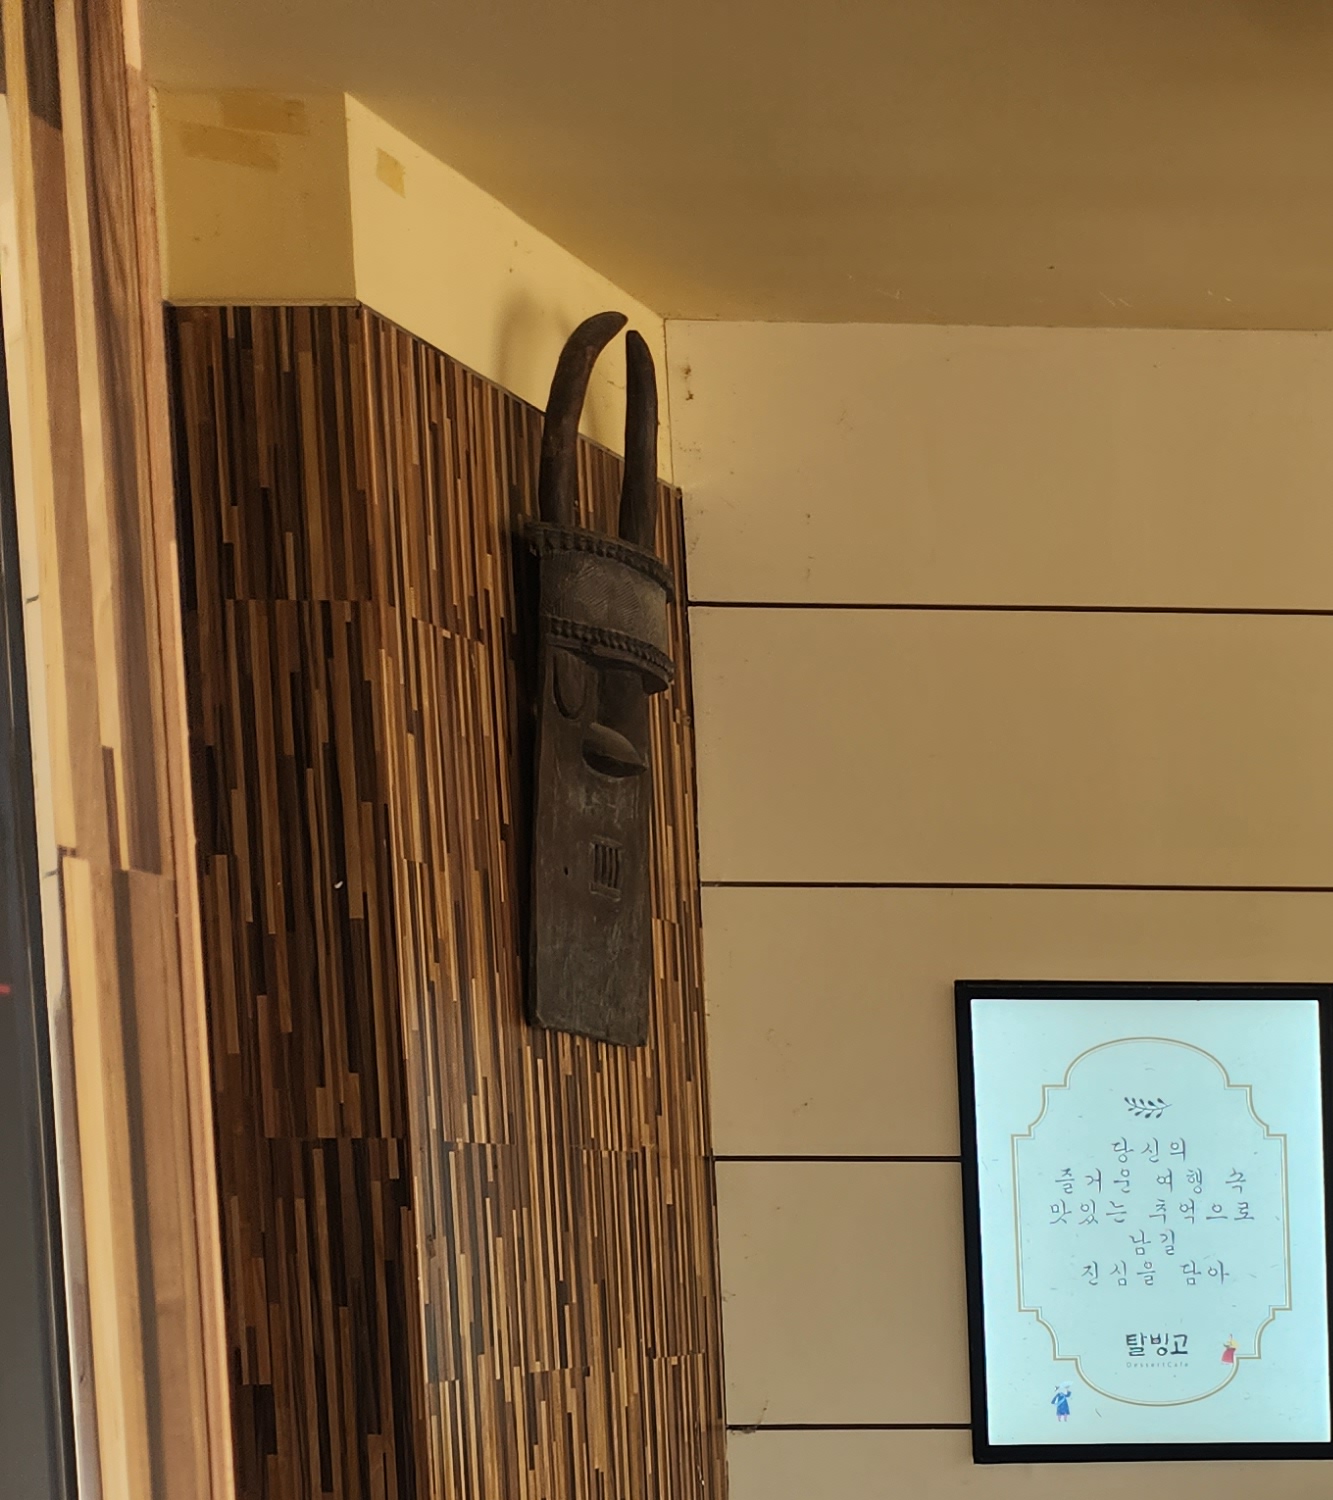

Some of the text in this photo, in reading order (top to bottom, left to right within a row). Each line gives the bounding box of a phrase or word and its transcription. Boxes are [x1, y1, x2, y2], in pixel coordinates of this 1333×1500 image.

[1110, 1137, 1187, 1163] 당신의
[1054, 1168, 1247, 1194] 즐거운 여행 속
[1049, 1199, 1255, 1225] 맛있는 추억으로
[1128, 1229, 1176, 1256] 남길
[1081, 1260, 1230, 1287] 진심을 담아
[1125, 1332, 1189, 1357] 탈빙고
